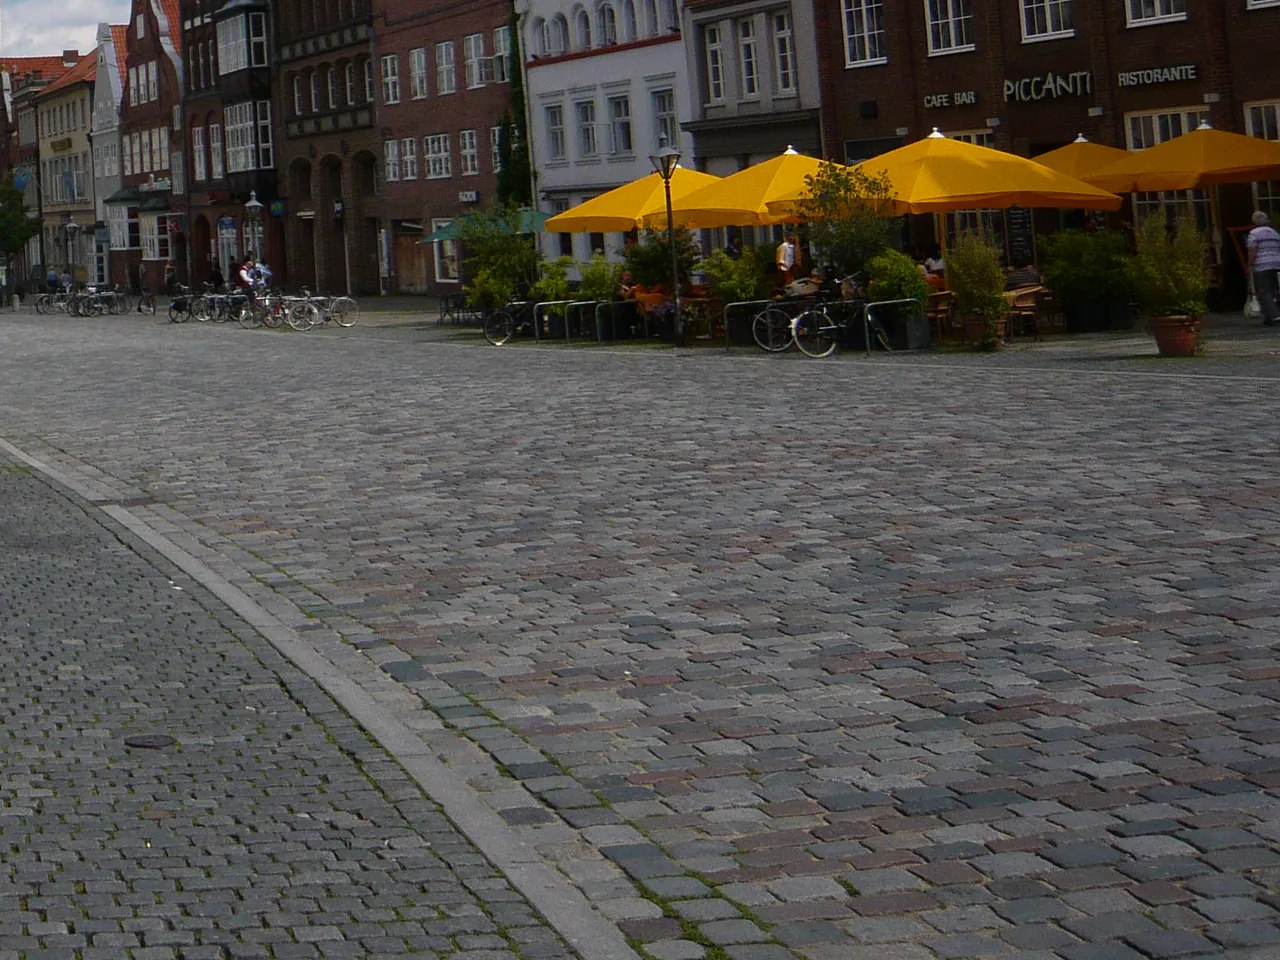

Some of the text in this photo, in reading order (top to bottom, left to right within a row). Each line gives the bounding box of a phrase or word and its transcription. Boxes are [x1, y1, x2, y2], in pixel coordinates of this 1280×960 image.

[1003, 71, 1091, 103] PICCANTI
[1118, 65, 1196, 87] RISTORANTE
[923, 91, 976, 108] CAFE BAR
